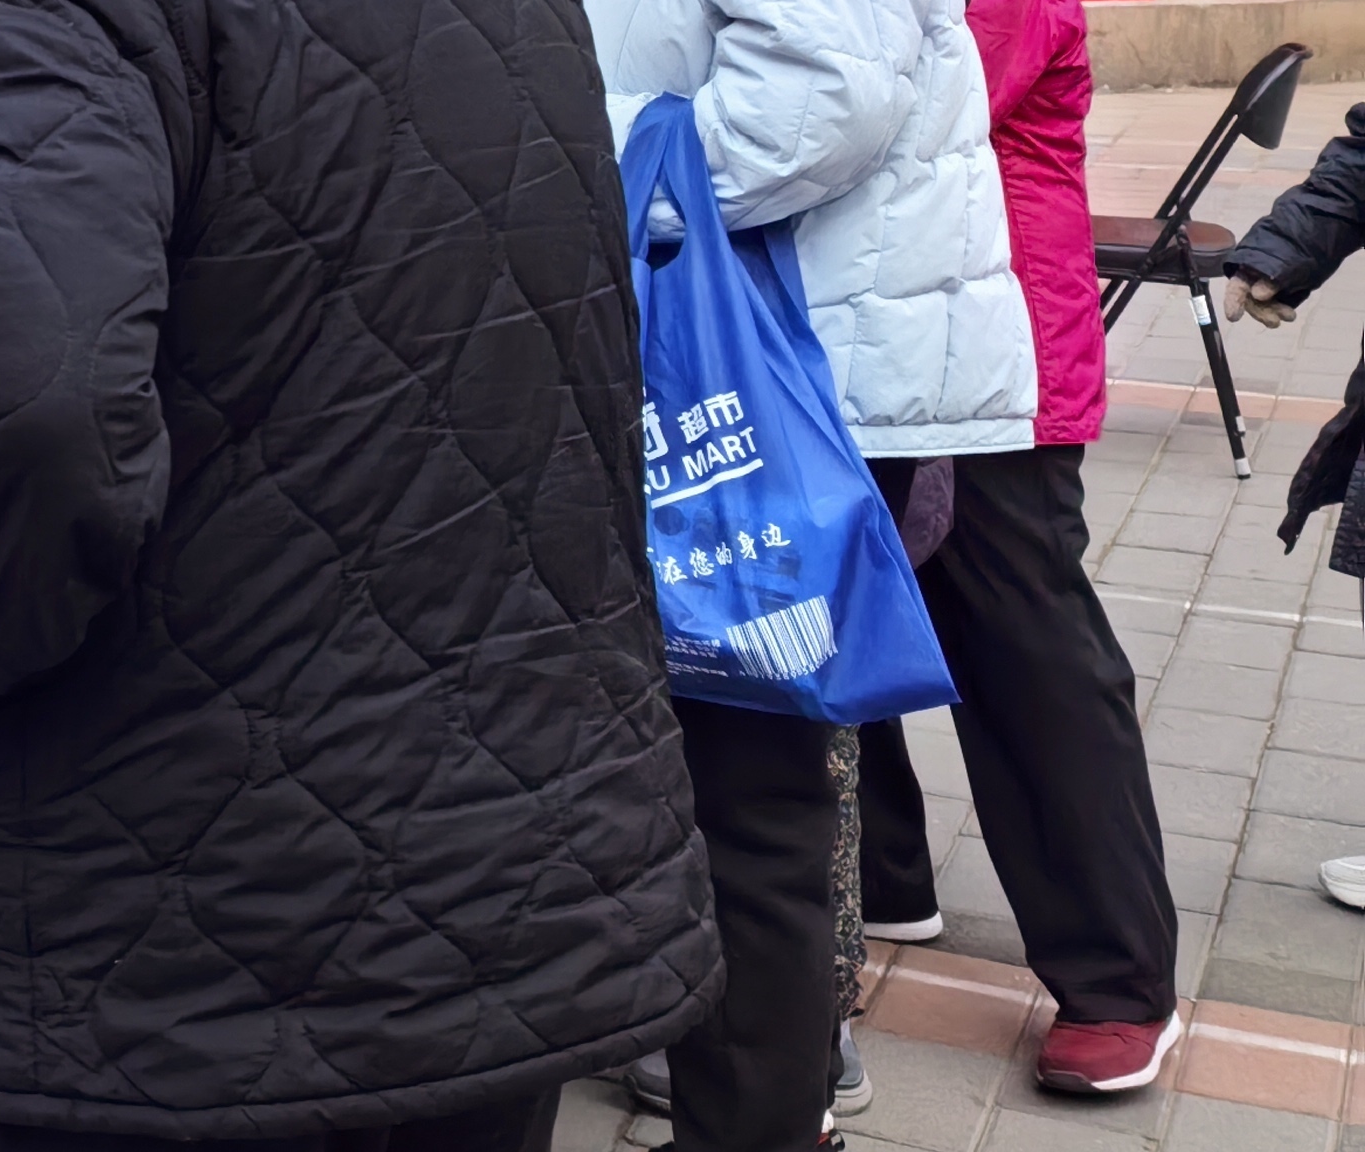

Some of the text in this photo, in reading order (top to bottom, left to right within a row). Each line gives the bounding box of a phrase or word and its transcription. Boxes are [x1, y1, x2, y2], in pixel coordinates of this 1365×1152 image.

[677, 391, 744, 444] 超市
[682, 426, 757, 480] MART
[648, 523, 792, 586] 在您的身边
